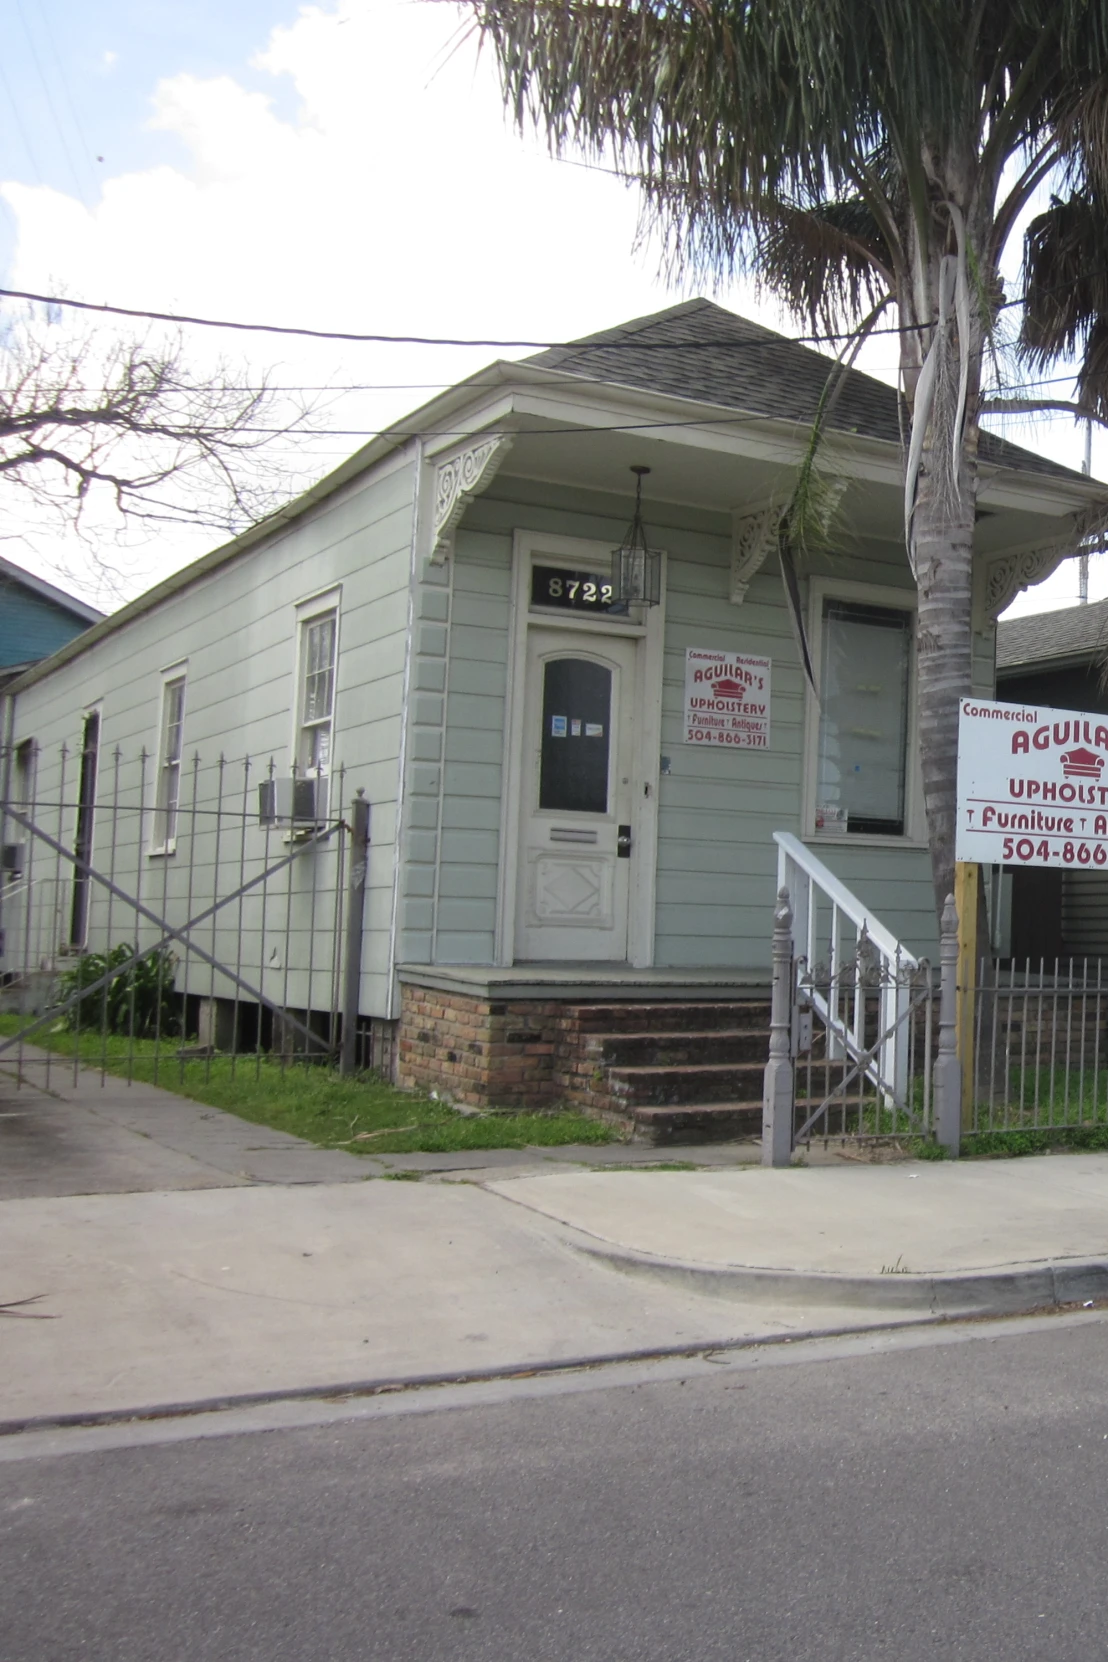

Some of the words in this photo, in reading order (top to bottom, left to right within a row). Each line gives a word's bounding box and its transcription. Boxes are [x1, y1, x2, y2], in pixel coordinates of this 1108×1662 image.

[549, 578, 612, 604] 8722
[689, 651, 726, 662] Commercial
[736, 656, 769, 667] Residential
[694, 664, 764, 690] AGUILAR'S
[690, 697, 766, 715] UPHOLSTERY
[963, 703, 1038, 723] Commercial
[692, 713, 725, 727] Furniture
[732, 717, 763, 732] Antiques
[688, 729, 766, 746] 504-866-3171
[982, 806, 1074, 833] Furniture
